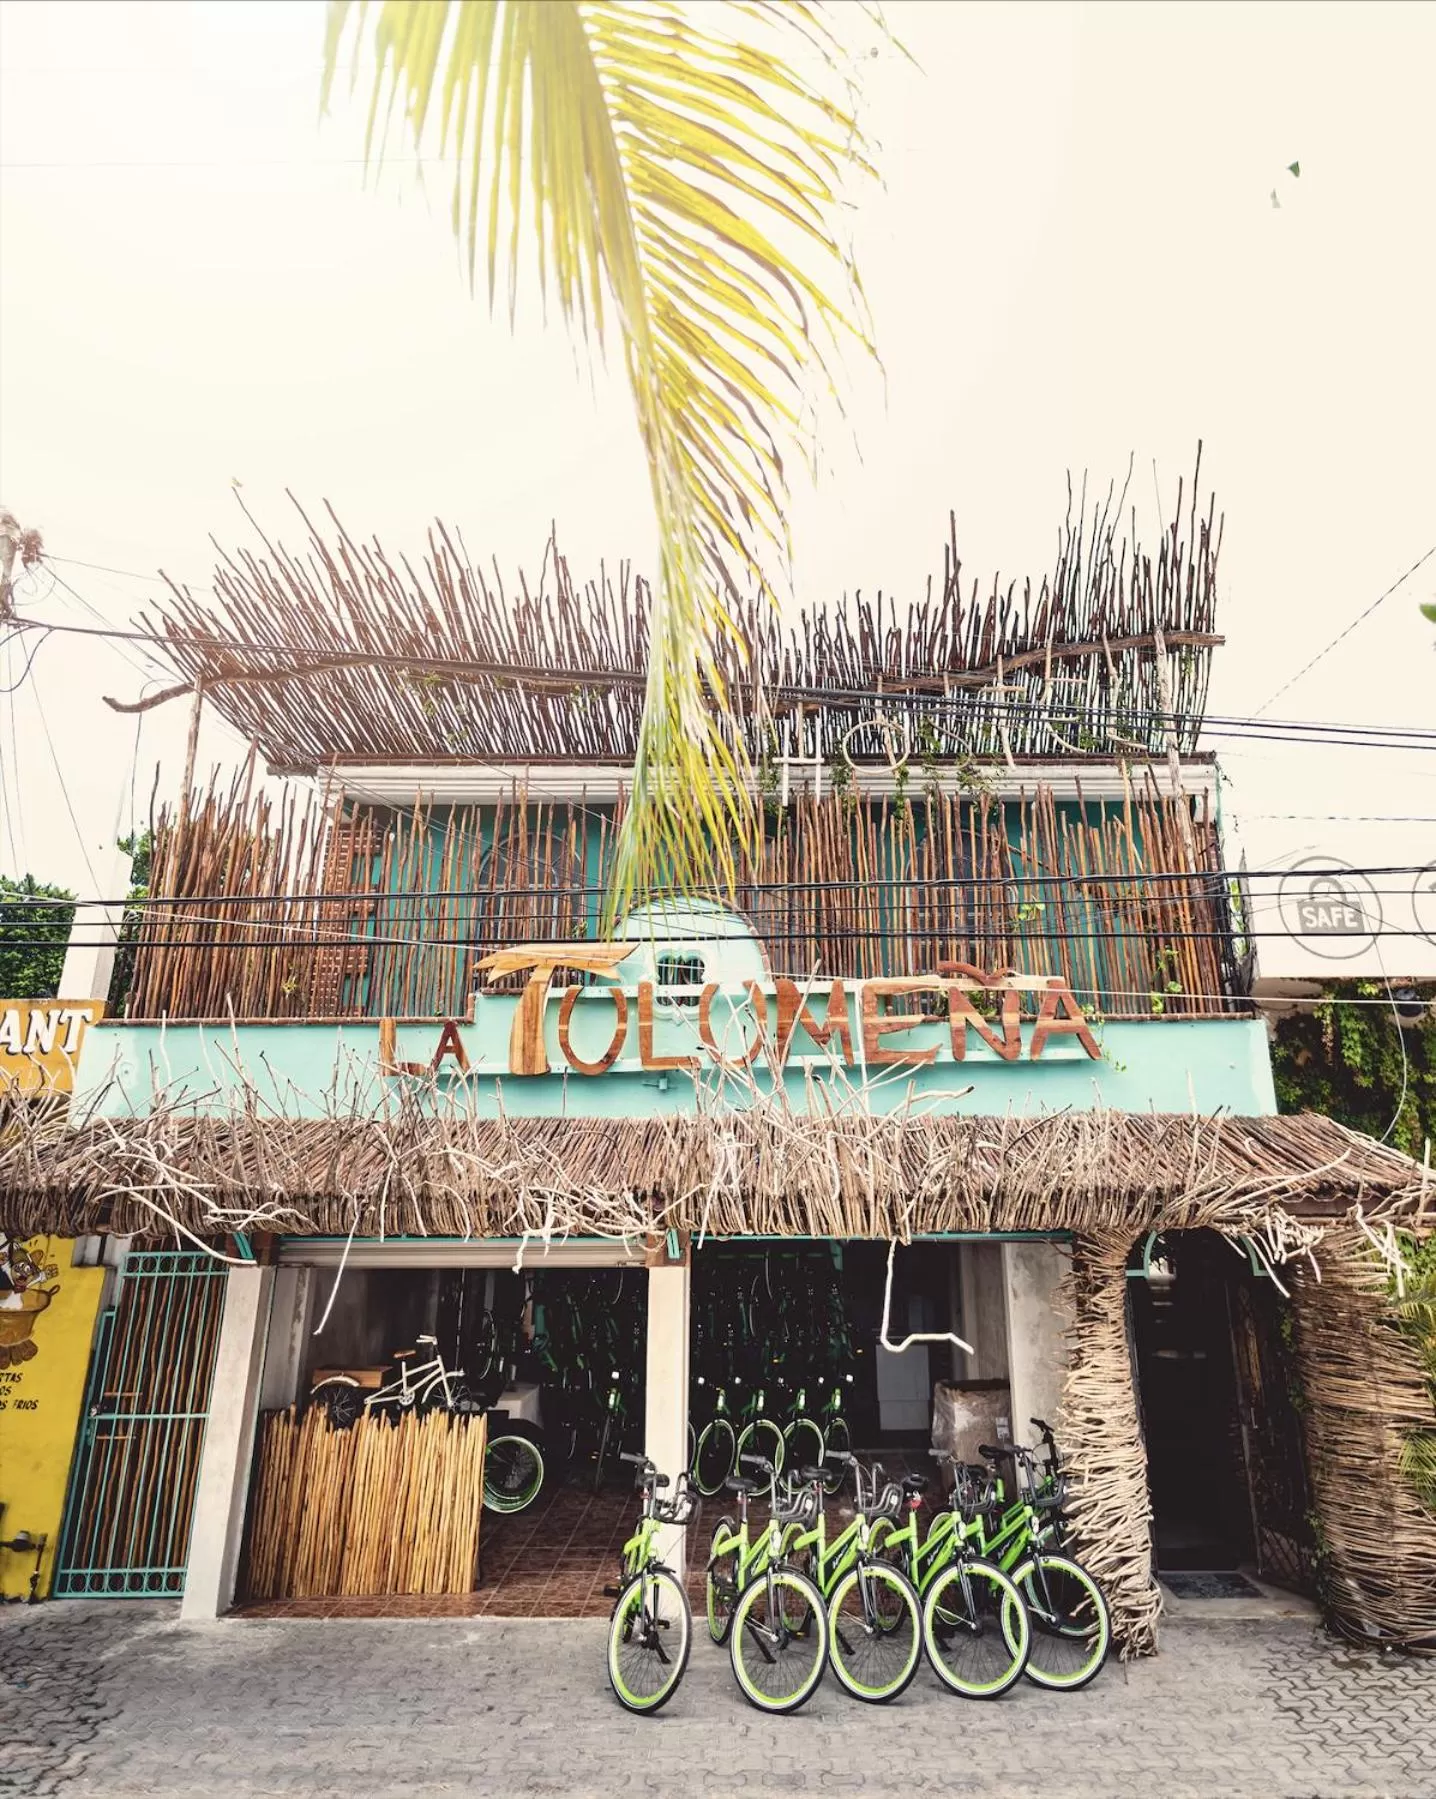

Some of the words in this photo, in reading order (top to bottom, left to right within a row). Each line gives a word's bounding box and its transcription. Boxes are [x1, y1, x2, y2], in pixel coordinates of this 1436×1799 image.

[1302, 906, 1359, 929] SAFE
[0, 1008, 93, 1055] ANT
[379, 1018, 472, 1077] LA
[473, 943, 1103, 1076] TOLOMEÑA
